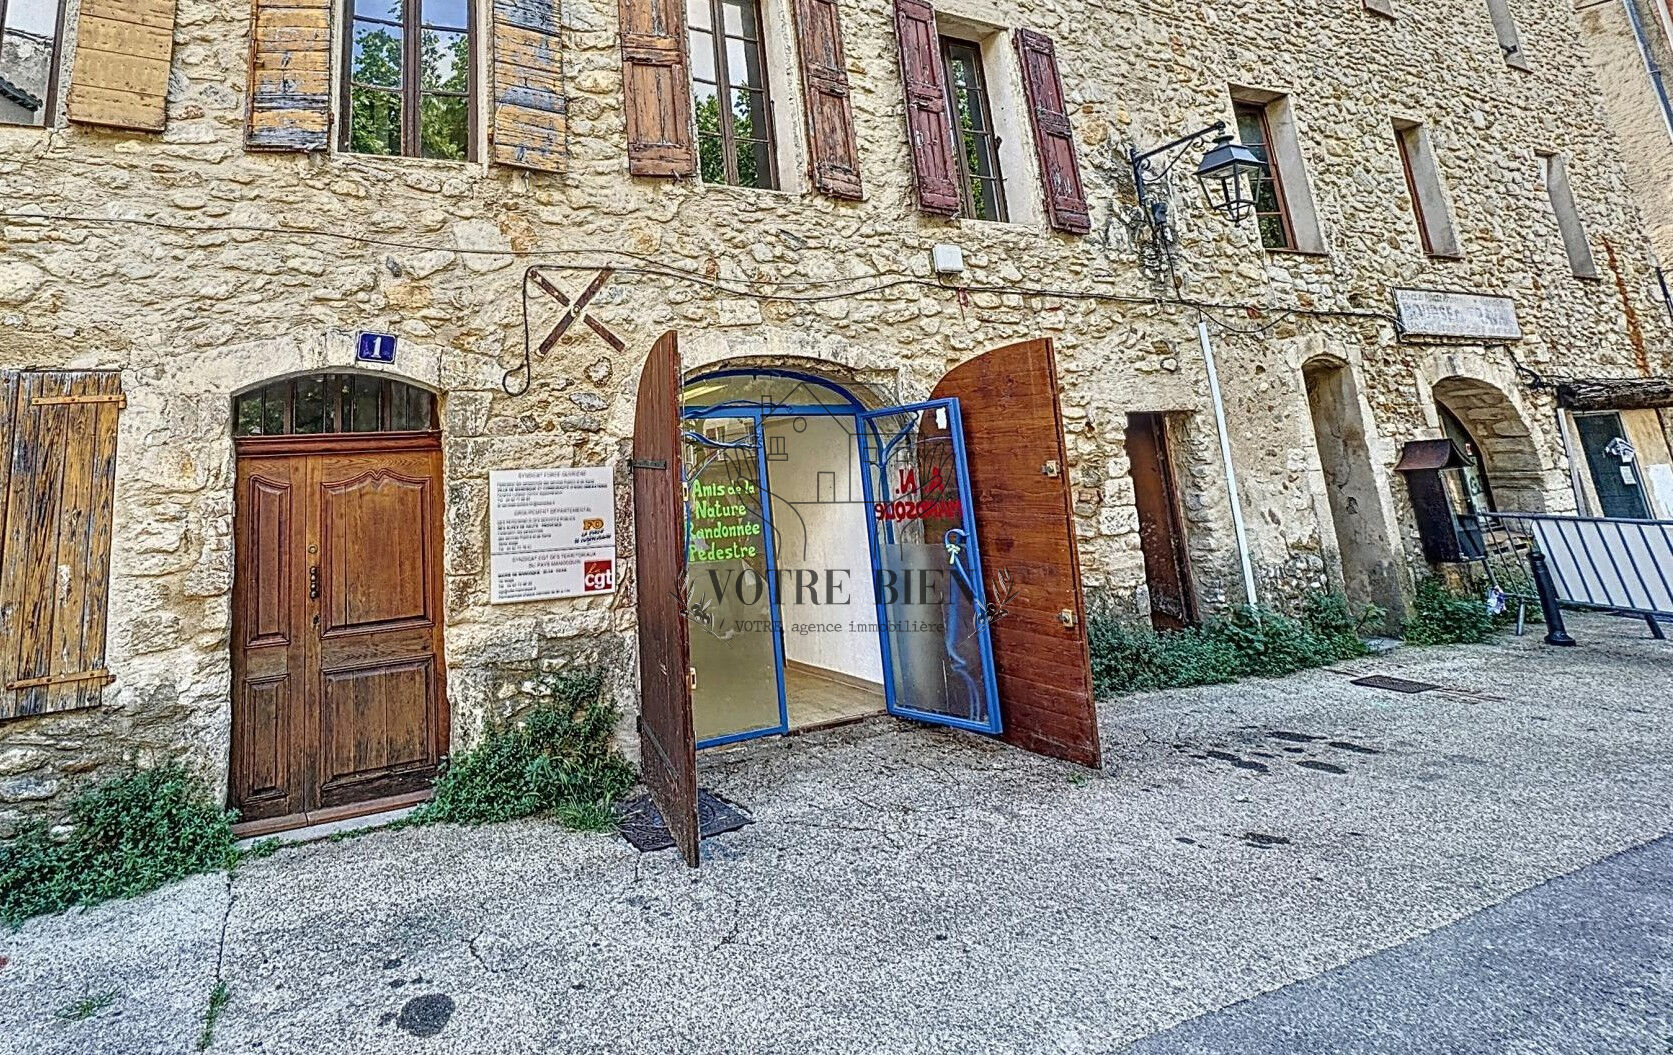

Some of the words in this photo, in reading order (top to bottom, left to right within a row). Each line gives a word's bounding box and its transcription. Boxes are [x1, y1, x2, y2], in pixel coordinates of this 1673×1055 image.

[371, 337, 382, 358] 1
[692, 479, 725, 497] Amis
[728, 480, 742, 495] de
[744, 480, 755, 494] la
[695, 500, 747, 519] Nature
[583, 518, 604, 531] FO
[584, 568, 612, 589] cgt
